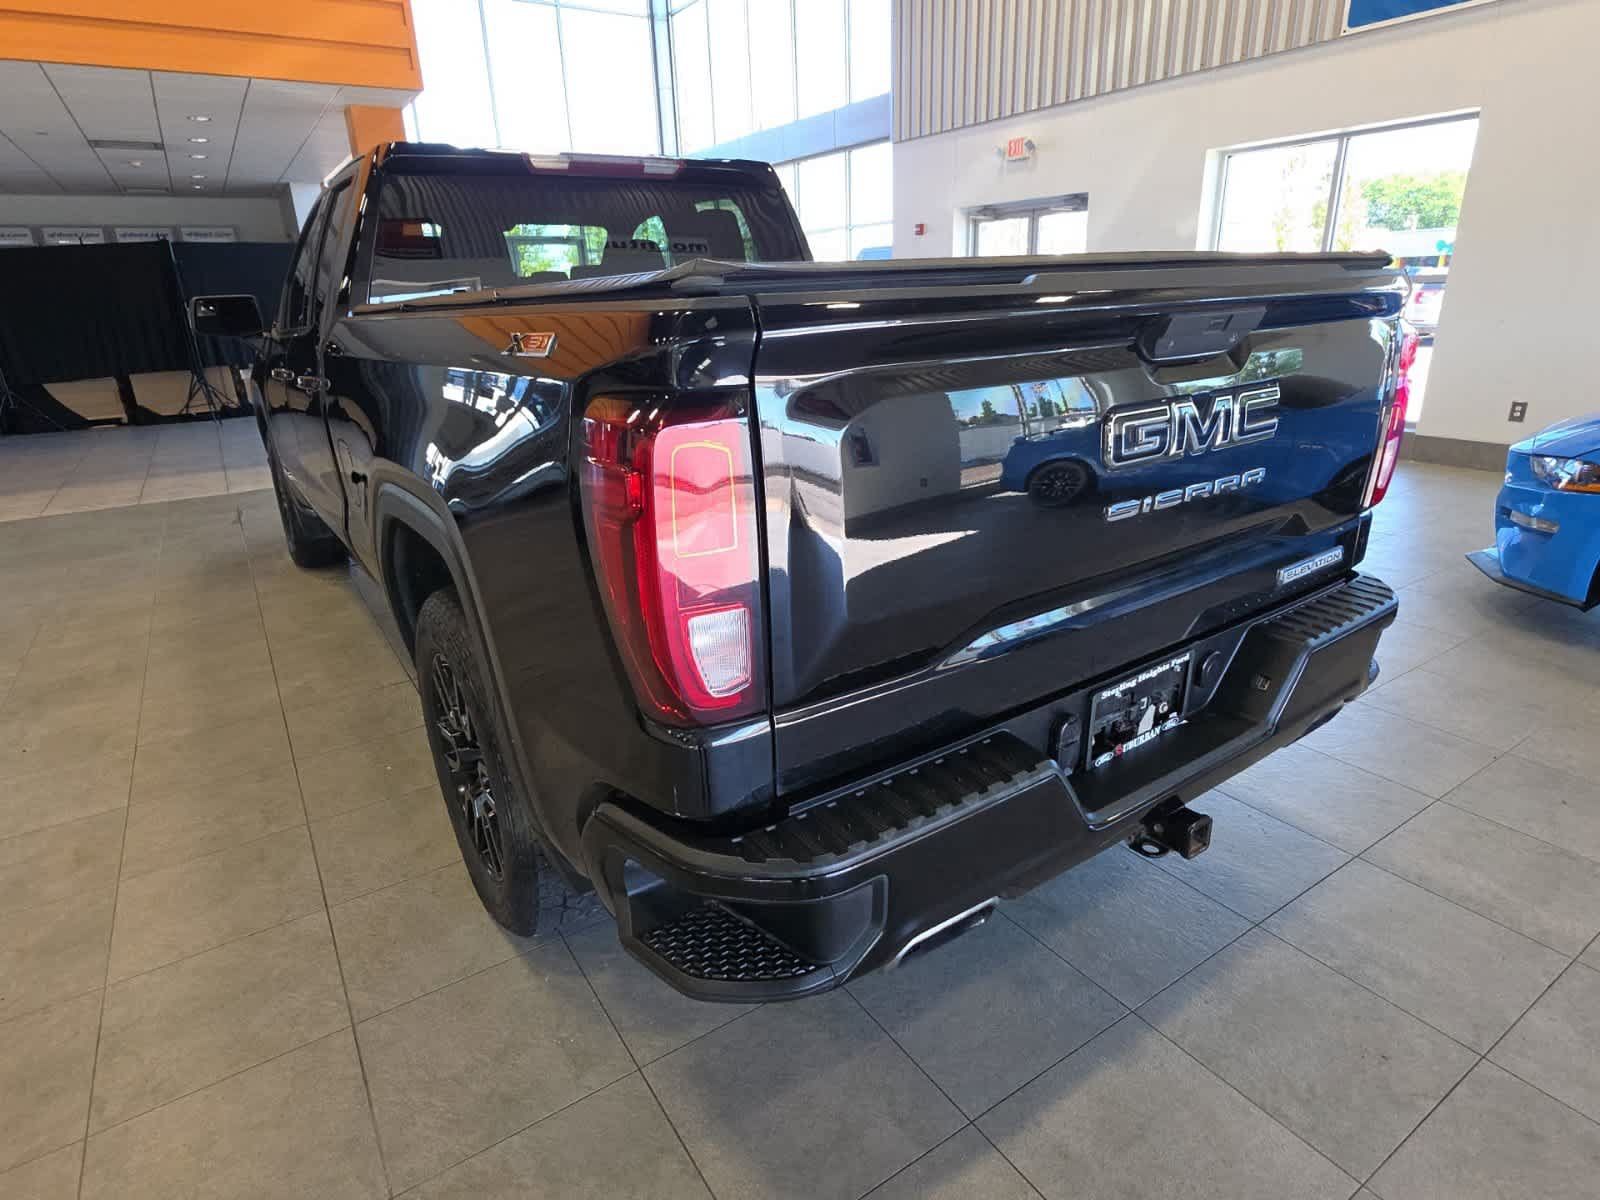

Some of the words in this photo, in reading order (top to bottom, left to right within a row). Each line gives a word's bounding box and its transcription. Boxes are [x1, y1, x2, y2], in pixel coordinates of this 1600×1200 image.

[1007, 136, 1024, 157] EXIT
[1102, 386, 1281, 471] GMC
[1103, 467, 1266, 522] SIERRA
[1286, 551, 1341, 578] ELEVATION
[1101, 679, 1137, 699] Sterling
[1137, 663, 1170, 682] Heights
